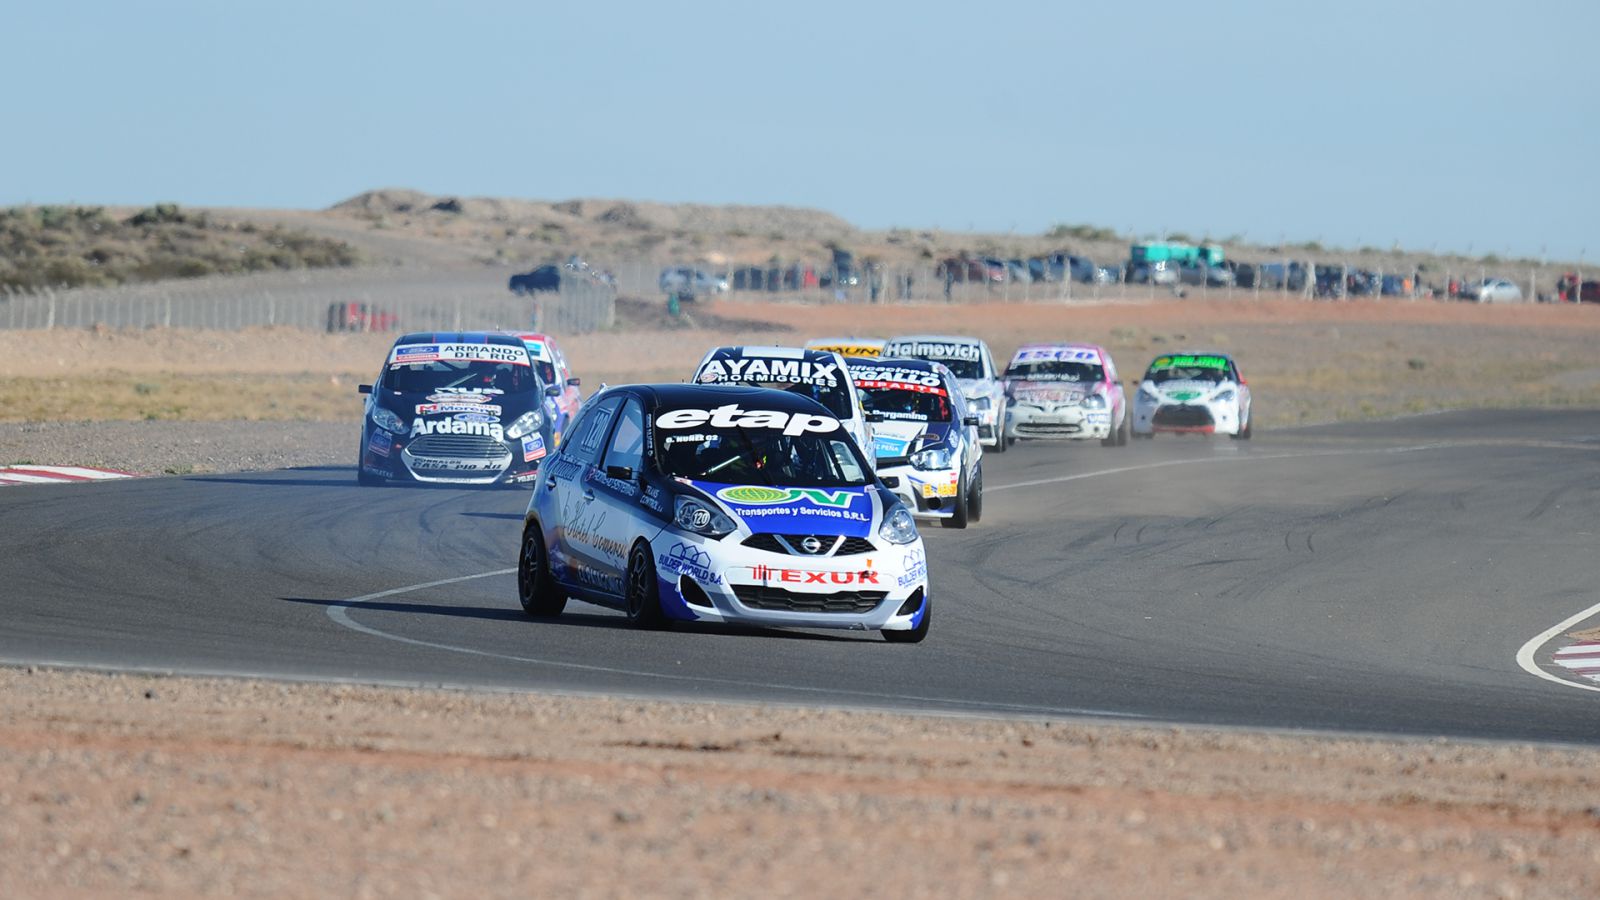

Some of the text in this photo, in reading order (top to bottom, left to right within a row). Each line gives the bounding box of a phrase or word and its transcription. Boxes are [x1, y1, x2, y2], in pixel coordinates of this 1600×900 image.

[444, 345, 524, 357] ARMANDO
[454, 351, 518, 361] DEL RIO
[887, 342, 980, 362] Haimovich
[702, 359, 838, 381] AYAMIX
[718, 374, 838, 388] HORMIGONES
[655, 403, 841, 437] etap
[410, 416, 504, 442] Ardama
[694, 511, 709, 527] 120
[735, 507, 790, 518] Transportes
[792, 508, 799, 517] y
[800, 506, 842, 518] Servicios
[659, 553, 683, 571] BUILDER
[682, 562, 709, 581] WORLD
[781, 569, 880, 584] EXUR
